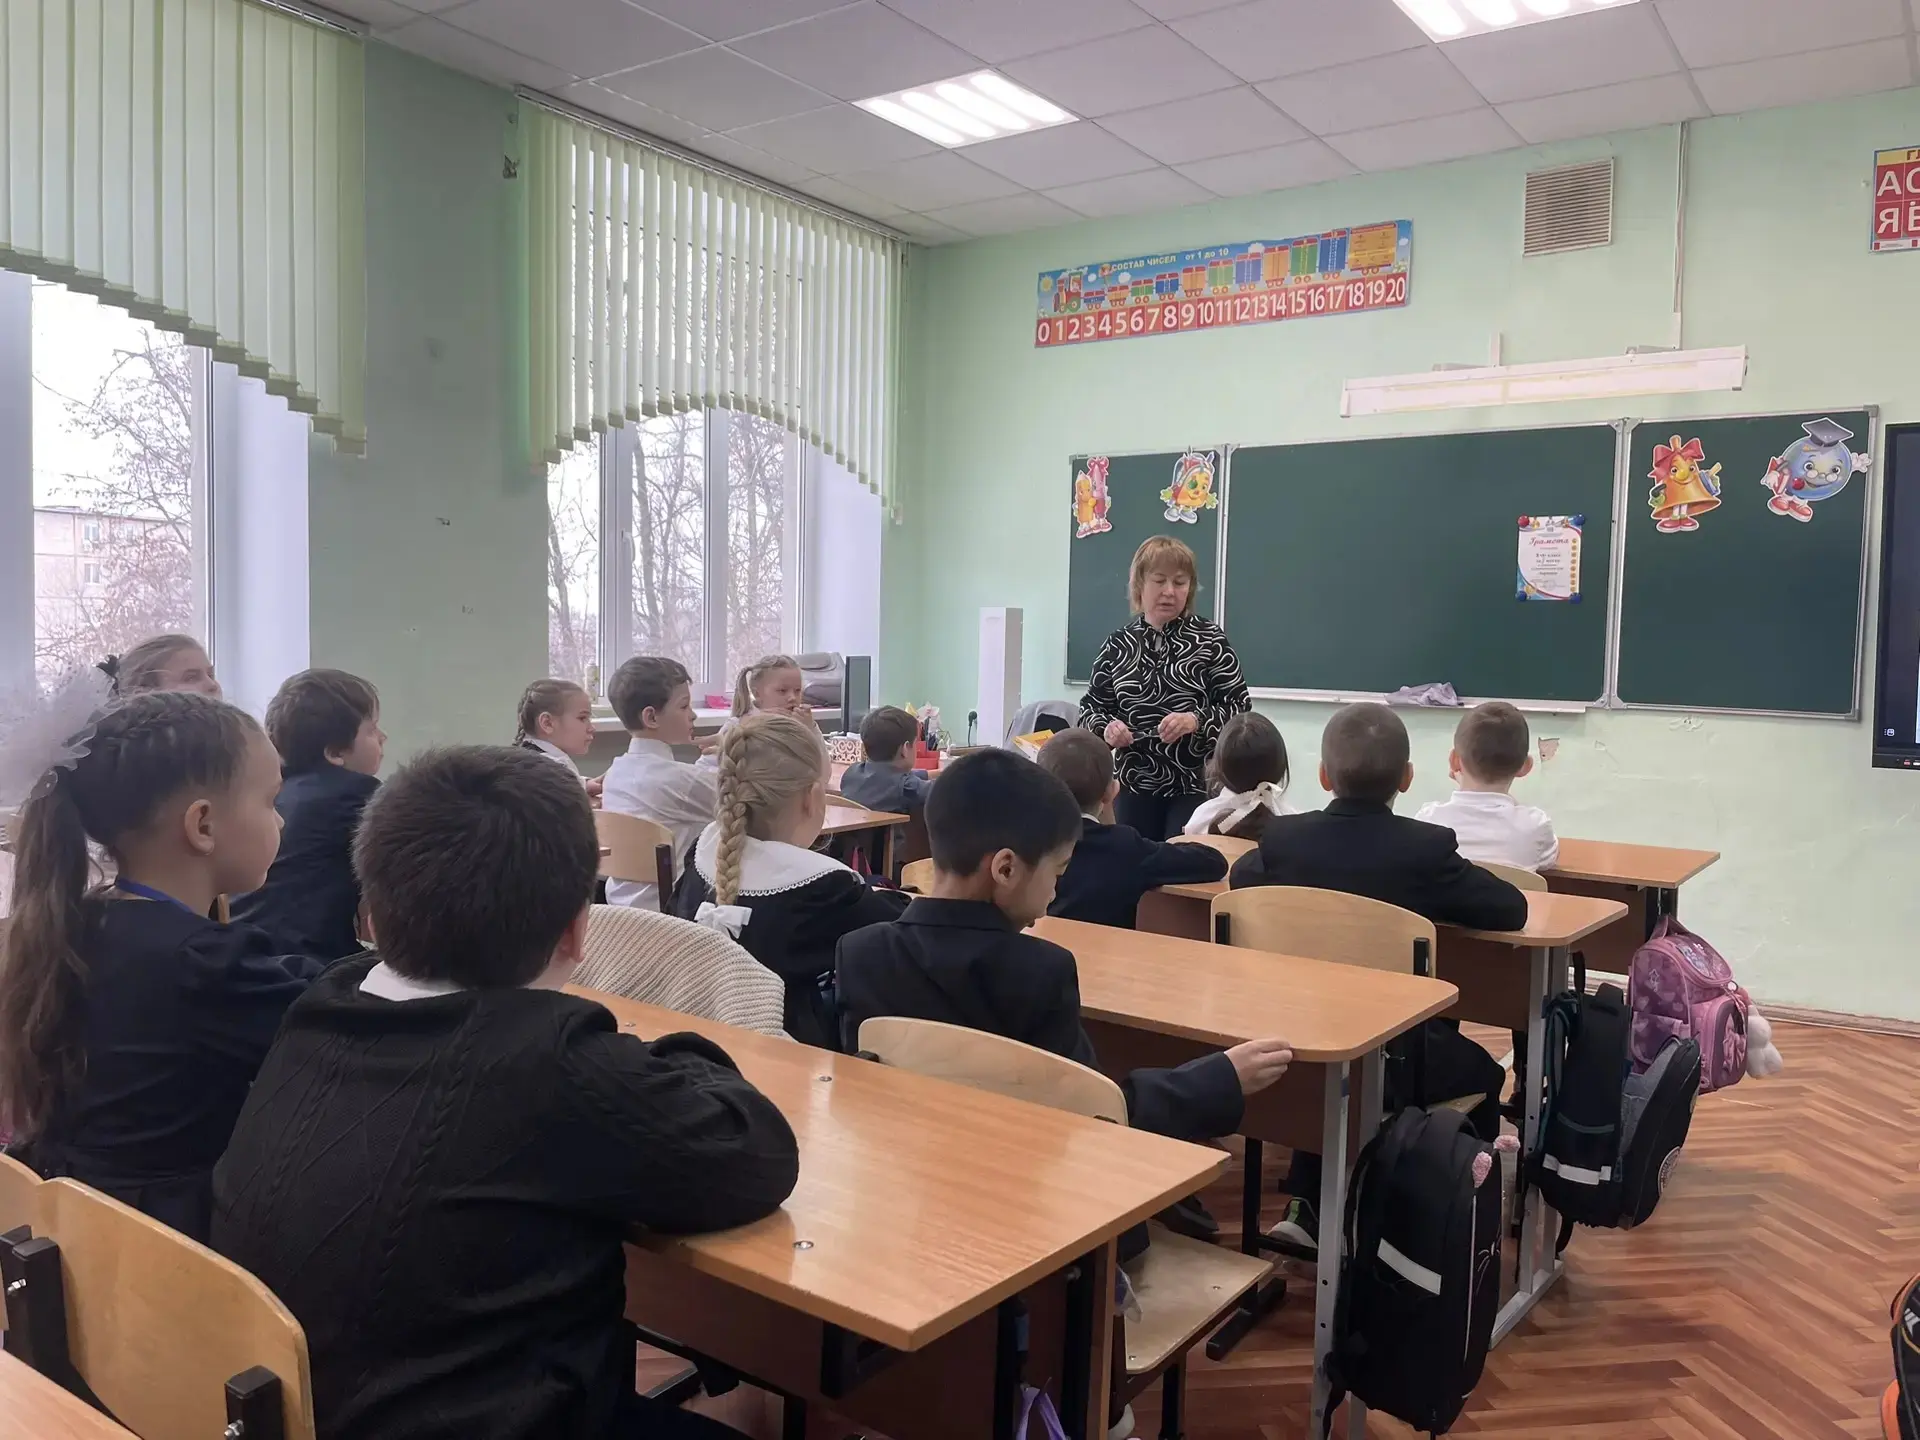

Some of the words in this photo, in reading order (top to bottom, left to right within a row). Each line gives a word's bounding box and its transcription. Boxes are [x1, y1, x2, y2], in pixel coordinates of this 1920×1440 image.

[1877, 207, 1900, 234] Я
[1111, 258, 1145, 272] СОСТАВ
[1147, 255, 1177, 266] ЧИСЕЛ
[1204, 251, 1216, 259] до
[1218, 247, 1229, 256] 10
[1038, 322, 1049, 342] 0
[1056, 320, 1063, 340] 1
[1068, 318, 1080, 339] 2
[1084, 316, 1095, 337] 3
[1098, 314, 1112, 335] 4
[1115, 311, 1127, 334] 5
[1130, 309, 1144, 332] 6
[1147, 307, 1160, 330] 7
[1163, 305, 1177, 328] 8
[1181, 303, 1195, 326] 9
[1199, 300, 1214, 324] 10
[1216, 298, 1231, 322] 11
[1235, 297, 1250, 321] 12
[1252, 294, 1268, 319] 13
[1270, 292, 1287, 317] 14
[1288, 289, 1306, 314] 15
[1308, 286, 1325, 311] 16
[1327, 284, 1344, 309] 17
[1346, 282, 1364, 307] 18
[1367, 279, 1385, 304] 19
[1386, 277, 1405, 303] 20
